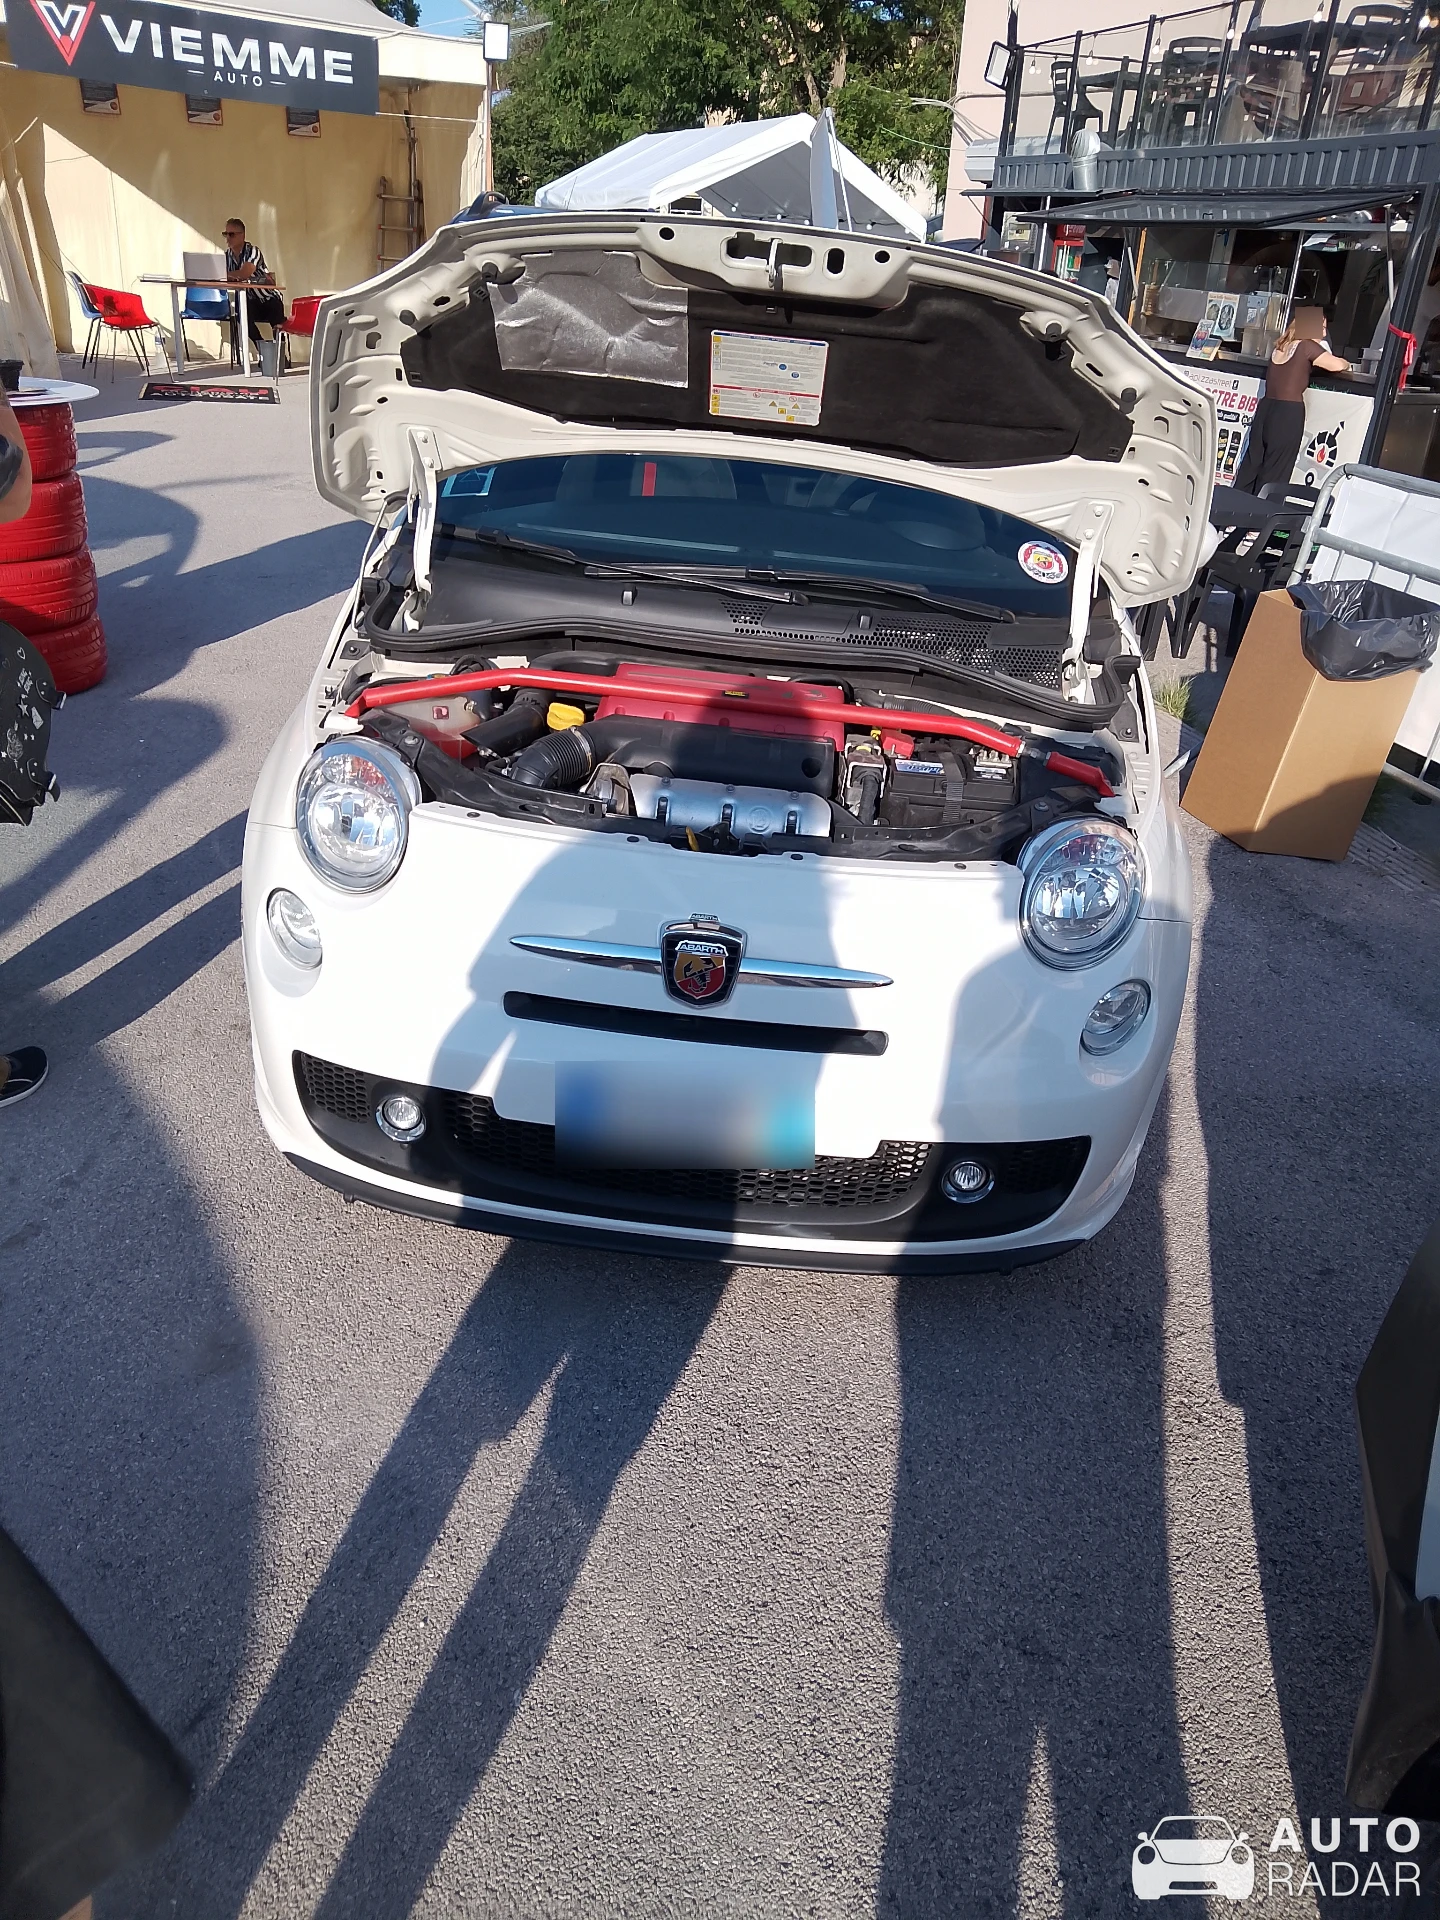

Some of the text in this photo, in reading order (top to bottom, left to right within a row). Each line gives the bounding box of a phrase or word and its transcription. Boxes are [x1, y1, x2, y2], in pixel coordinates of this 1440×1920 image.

[100, 14, 353, 84] VIEMME
[213, 70, 263, 87] AUTO
[1238, 395, 1258, 412] BIB
[680, 944, 723, 954] ABARTH
